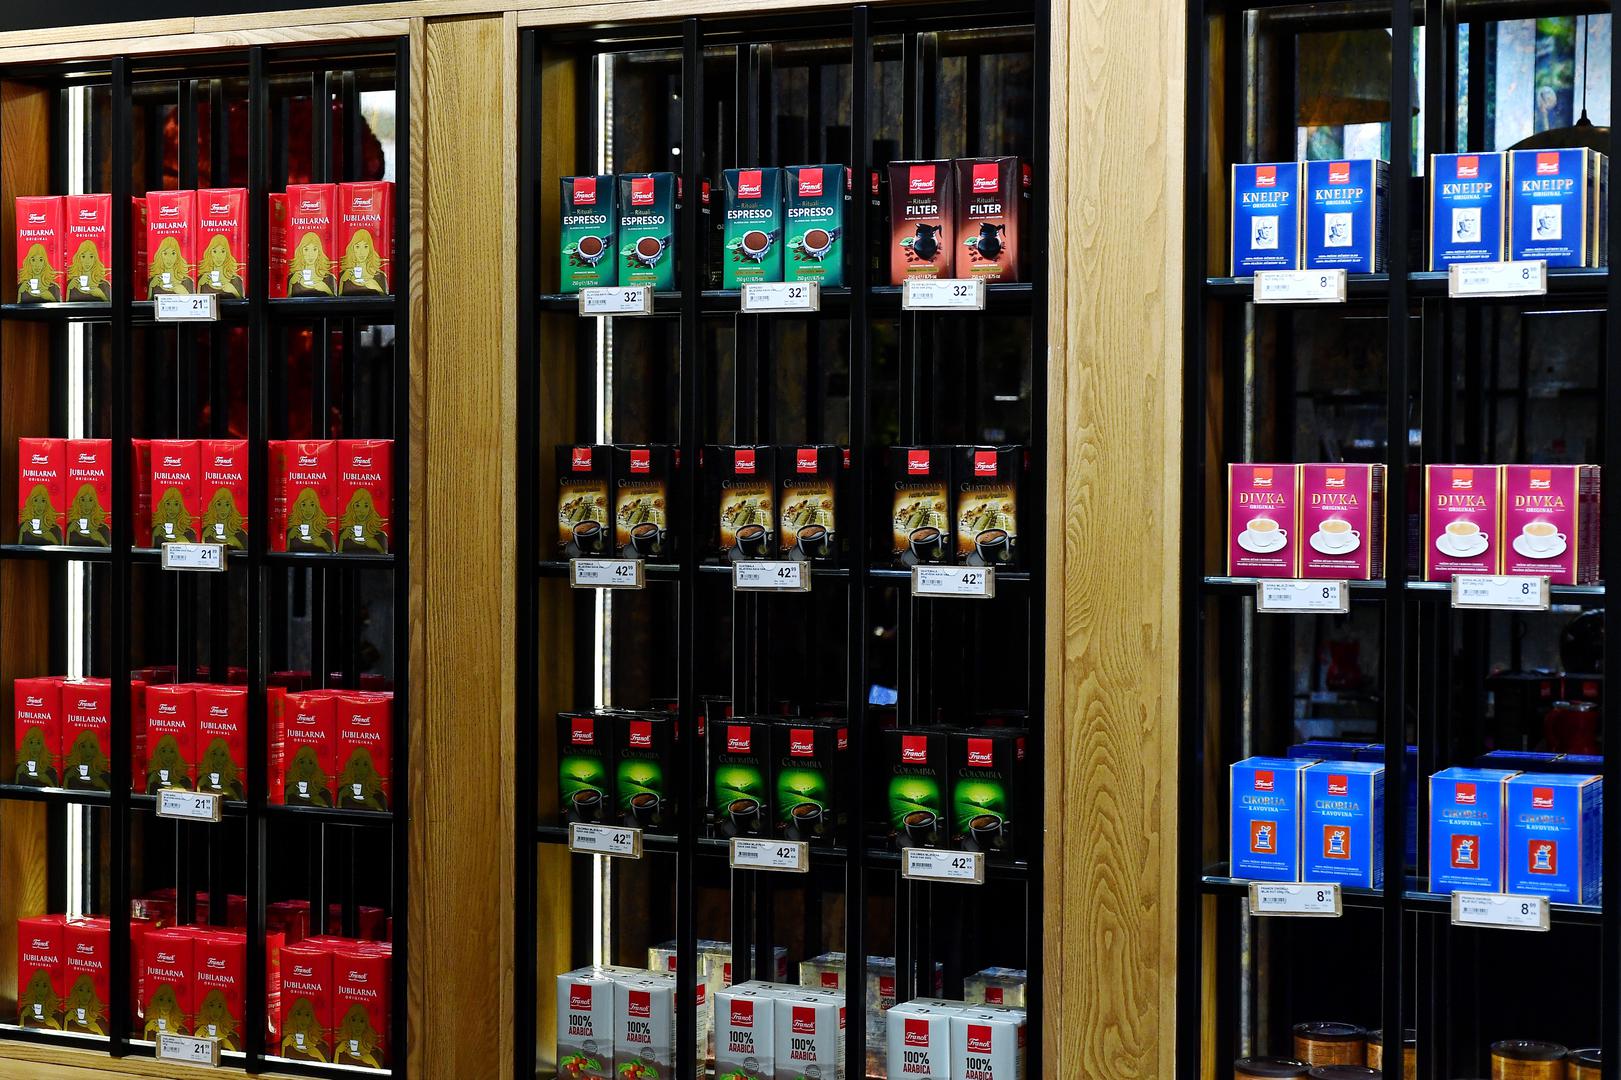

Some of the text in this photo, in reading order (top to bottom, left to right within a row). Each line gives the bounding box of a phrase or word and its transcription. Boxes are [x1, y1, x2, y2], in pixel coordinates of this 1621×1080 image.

[800, 182, 822, 191] Franck
[910, 179, 934, 189] Franck
[974, 178, 998, 187] Franck
[1521, 179, 1573, 192] KNEIPP
[739, 185, 761, 193] Franck
[1443, 183, 1492, 195] KNEIPP
[574, 191, 595, 200] Franck
[632, 192, 654, 200] Franck
[1243, 192, 1289, 203] KNEIPP
[1315, 189, 1363, 200] KNEIPP
[727, 209, 772, 219] ESPRESSO
[788, 207, 833, 217] ESPRESSO
[906, 205, 937, 214] FILTER
[970, 204, 1001, 214] FILTER
[291, 217, 329, 225] JUBILARNA
[343, 214, 381, 222] JUBILARNA
[564, 215, 606, 224] ESPRESSO
[622, 216, 664, 225] ESPRESSO
[70, 225, 105, 233] JUBILARNA
[151, 222, 187, 230] JUBILARNA
[20, 229, 54, 237] JUBILARNA
[1522, 268, 1529, 279] 8
[1321, 277, 1327, 287] 8
[788, 288, 802, 298] 32
[953, 286, 967, 296] 32
[624, 292, 636, 302] 32
[193, 300, 203, 309] 21
[975, 462, 997, 470] Franck
[23, 469, 56, 477] JUBILARNA
[154, 472, 190, 480] JUBILARNA
[205, 472, 242, 480] JUBILARNA
[289, 472, 327, 480] JUBILARNA
[343, 472, 381, 480] JUBILARNA
[1240, 493, 1285, 504] DIVKA
[1312, 494, 1358, 505] DIVKA
[1438, 495, 1486, 507] DIVKA
[1515, 496, 1564, 507] DIVKA
[201, 550, 212, 559] 21
[615, 566, 628, 576] 42
[778, 568, 791, 577] 42
[962, 574, 976, 584] 42
[1322, 587, 1329, 598] 8
[1522, 583, 1529, 594] 8
[18, 711, 51, 719] JUBILARNA
[68, 714, 107, 723] JUBILARNA
[150, 719, 186, 727] JUBILARNA
[201, 721, 237, 730] JUBILARNA
[287, 729, 325, 738] JUBILARNA
[342, 730, 380, 740] JUBILARNA
[572, 731, 593, 740] Franck
[630, 734, 650, 743] Franck
[728, 739, 750, 749] Franck
[791, 742, 813, 752] Franck
[903, 749, 926, 759] Franck
[969, 752, 991, 762] Franck
[195, 799, 206, 808] 21
[613, 834, 625, 844] 42
[777, 848, 790, 858] 42
[952, 858, 966, 868] 42
[1317, 891, 1324, 902] 8
[1521, 904, 1529, 915] 8
[23, 953, 58, 963] JUBILARNA
[68, 958, 102, 968] JUBILARNA
[147, 966, 184, 977] JUBILARNA
[198, 972, 234, 983] JUBILARNA
[284, 980, 322, 991] JUBILARNA
[338, 986, 377, 997] JUBILARNA
[571, 997, 591, 1005] Franck
[629, 1003, 649, 1012] Franck
[569, 1015, 592, 1027] 100%
[731, 1012, 753, 1022] Franck
[627, 1021, 650, 1034] 100%
[793, 1020, 814, 1029] Franck
[569, 1026, 593, 1036] ARABICA
[627, 1033, 651, 1043] ARABICA
[729, 1031, 753, 1043] 100%
[906, 1032, 928, 1041] Franck
[791, 1038, 815, 1051] 100%
[968, 1038, 991, 1048] Franck
[194, 1044, 204, 1054] 21
[729, 1043, 754, 1054] ARABICA
[791, 1050, 816, 1061] ARABICA
[904, 1051, 929, 1064] 100%
[903, 1064, 930, 1074] ARABICA
[966, 1058, 992, 1071] 100%
[966, 1071, 993, 1080] ARABICA
